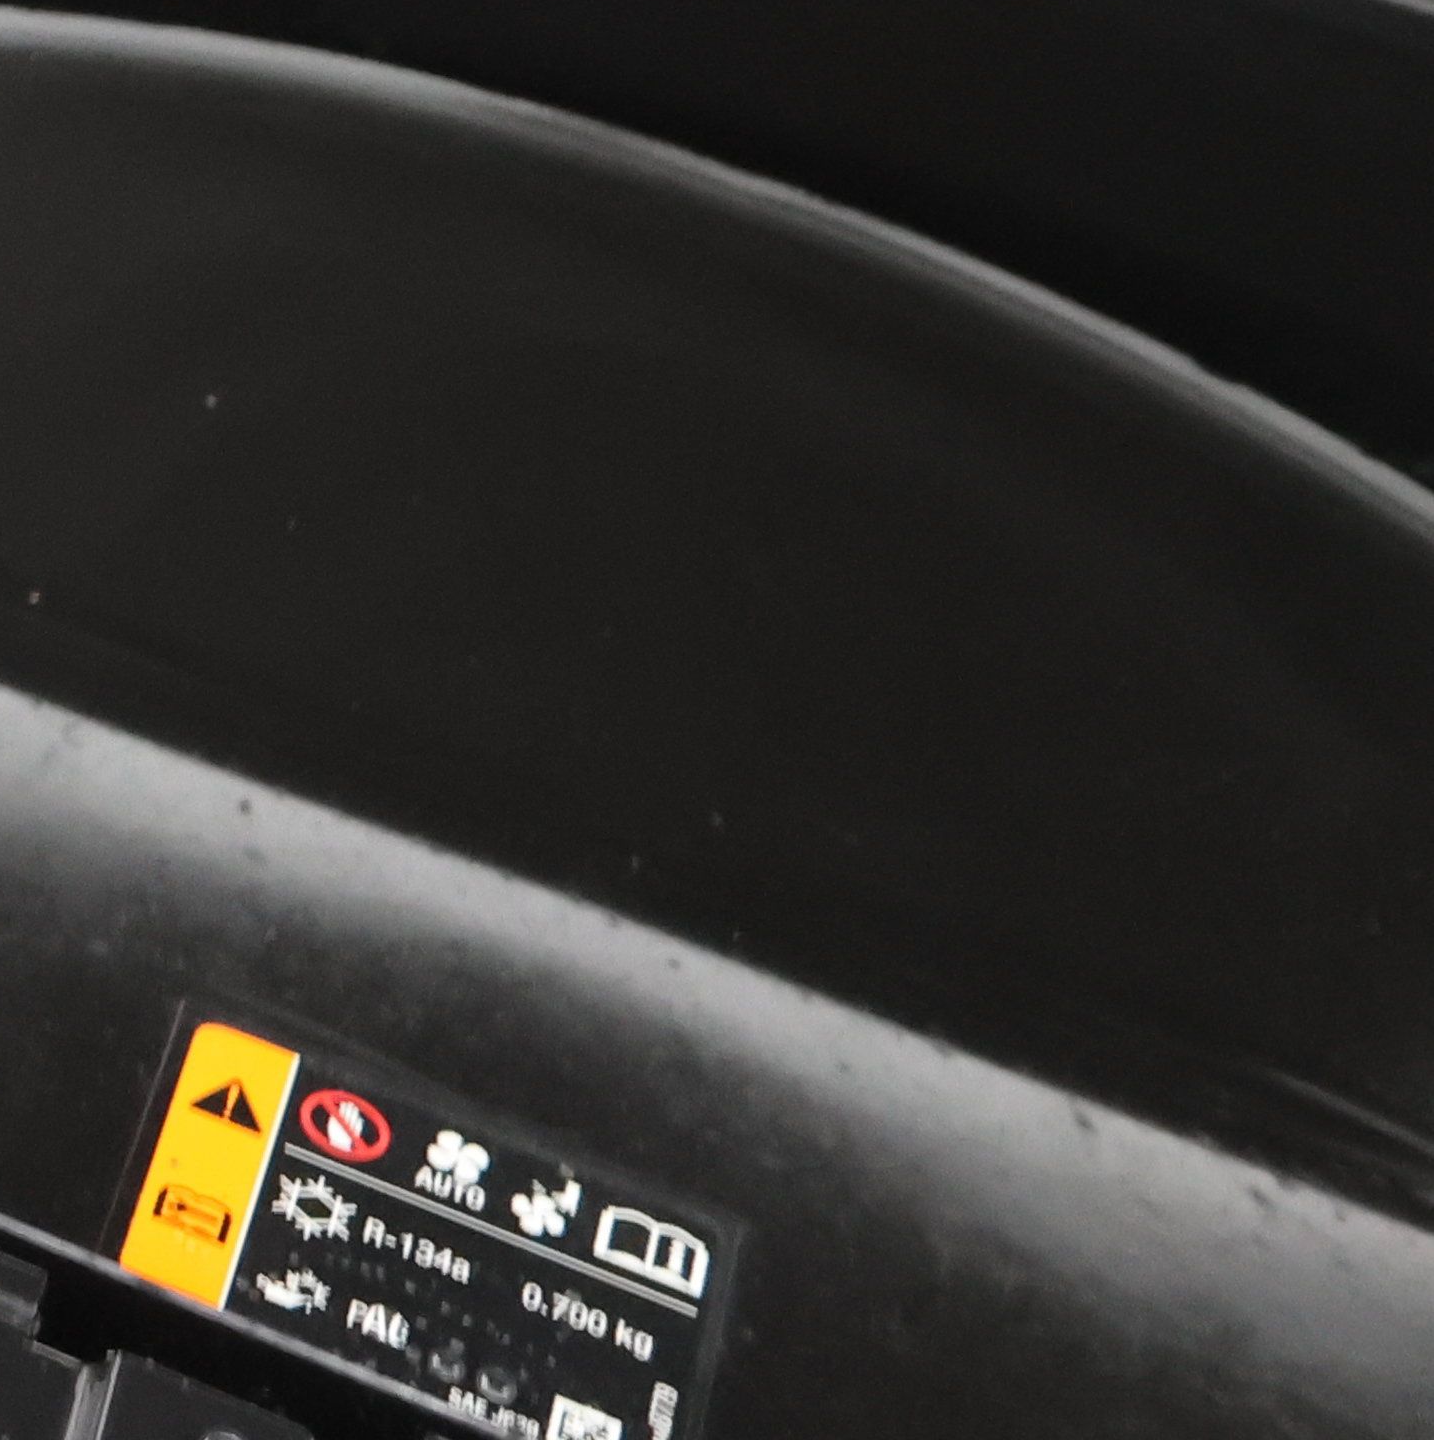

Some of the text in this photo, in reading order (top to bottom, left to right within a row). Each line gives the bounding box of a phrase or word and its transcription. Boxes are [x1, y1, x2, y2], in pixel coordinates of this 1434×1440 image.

[414, 1162, 488, 1213] AUTO
[363, 1216, 656, 1363] R-134a 0.700 kg
